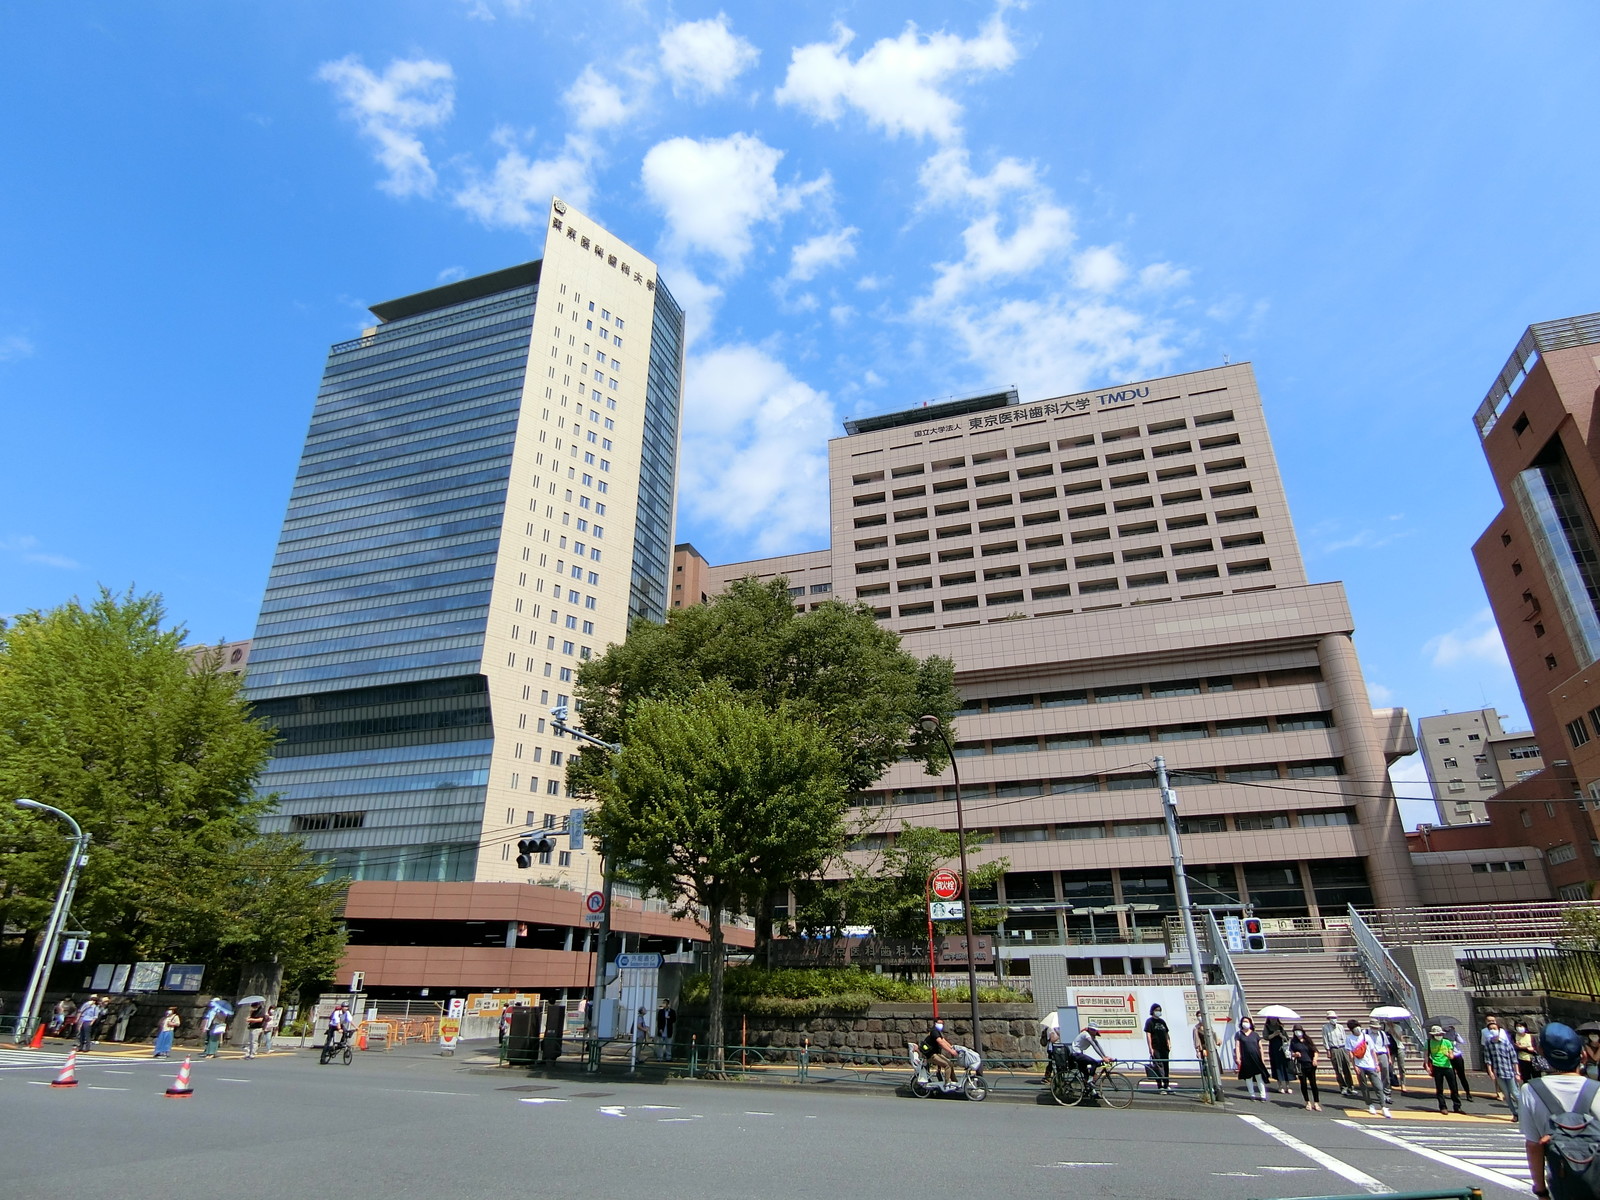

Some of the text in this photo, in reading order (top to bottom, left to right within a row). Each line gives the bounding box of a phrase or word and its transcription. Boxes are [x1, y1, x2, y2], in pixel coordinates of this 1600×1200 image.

[914, 386, 1150, 437] 国立大学法人 東京医科歯科大学 TMDU
[935, 880, 955, 890] 消火栓
